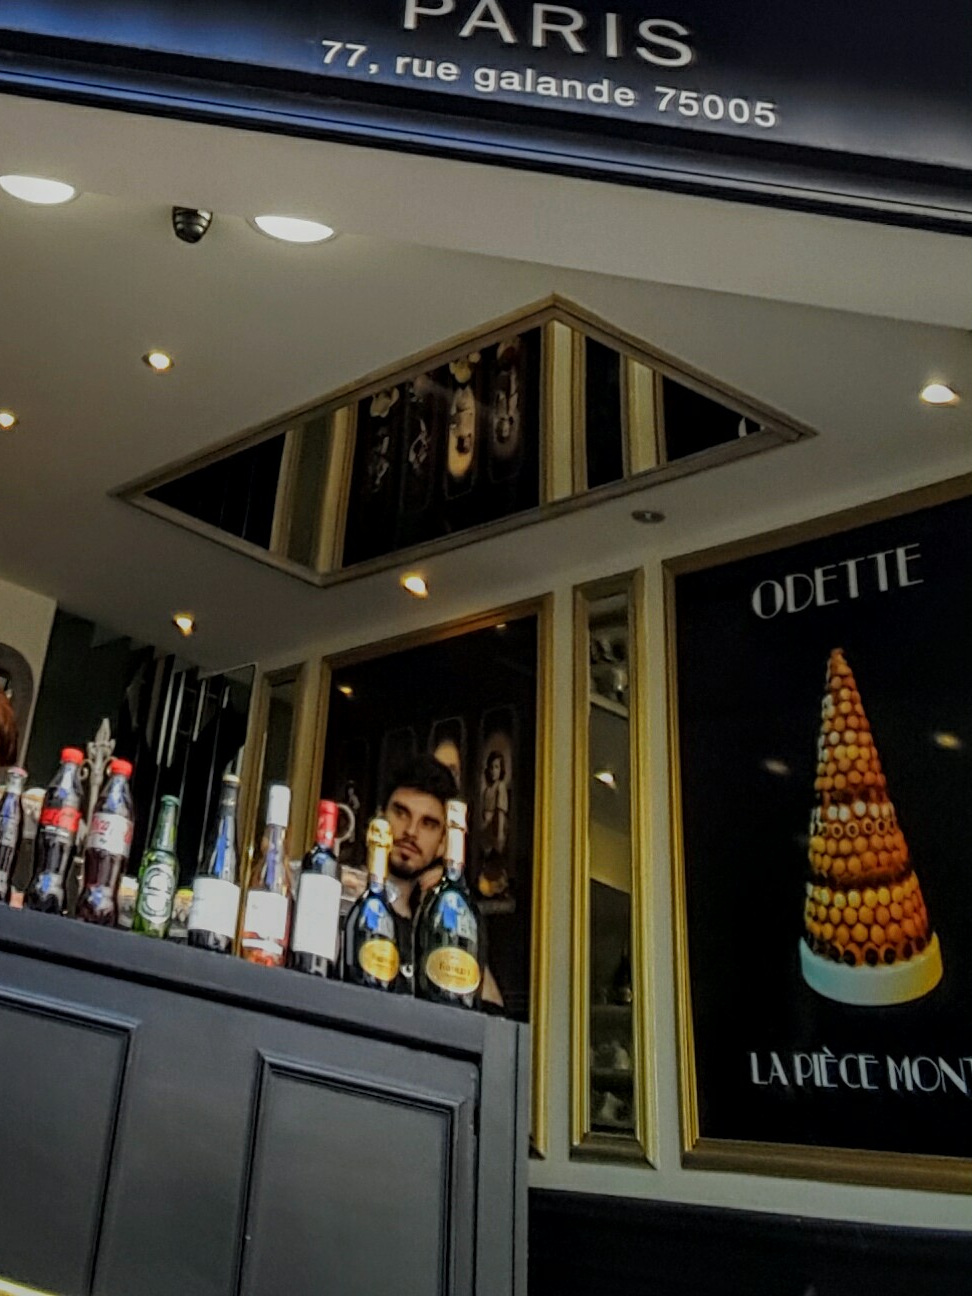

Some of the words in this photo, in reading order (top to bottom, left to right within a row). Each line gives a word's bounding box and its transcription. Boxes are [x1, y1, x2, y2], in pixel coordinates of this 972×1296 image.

[322, 40, 379, 74] 77,
[395, 53, 459, 82] rue
[474, 64, 636, 107] galande
[655, 86, 778, 128] 75005
[752, 543, 925, 620] ODETTE
[750, 1051, 789, 1086] LA
[793, 1045, 879, 1090] PIÈCE
